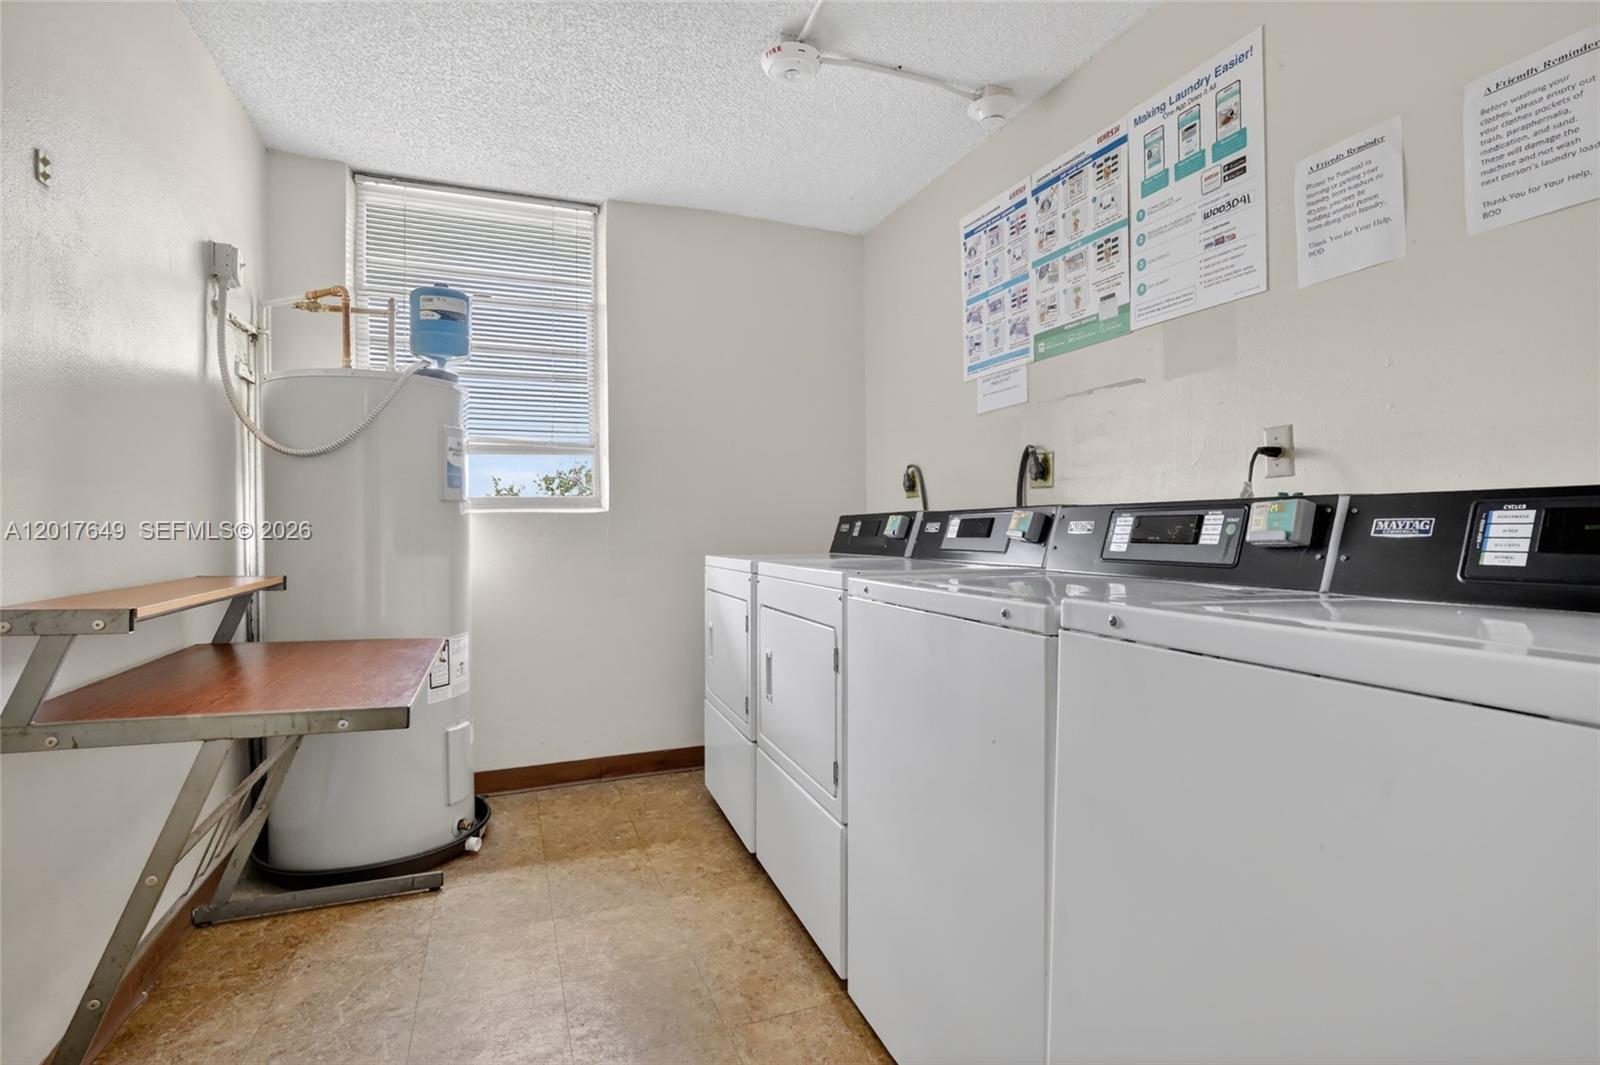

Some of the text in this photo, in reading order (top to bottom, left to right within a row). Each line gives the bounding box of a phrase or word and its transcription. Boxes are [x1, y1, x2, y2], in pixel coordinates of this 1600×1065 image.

[765, 44, 783, 58] FIRE
[1483, 41, 1599, 95] A Friendly Reminder
[1133, 45, 1254, 128] Making Laundry Easier!
[1480, 74, 1570, 117] Before washing your
[1515, 96, 1544, 113] please
[1546, 82, 1577, 101] empty
[1578, 75, 1597, 87] out
[1480, 89, 1584, 137] your clothes pockets of
[1533, 125, 1550, 137] and
[1480, 137, 1582, 177] machine and not wash
[1481, 126, 1580, 166] These will damage the
[1480, 175, 1499, 187] next
[1501, 163, 1539, 181] person's
[1541, 150, 1577, 167] laundry
[1482, 169, 1593, 208] Thank You for Your Help,
[1375, 520, 1431, 530] MAYTAG
